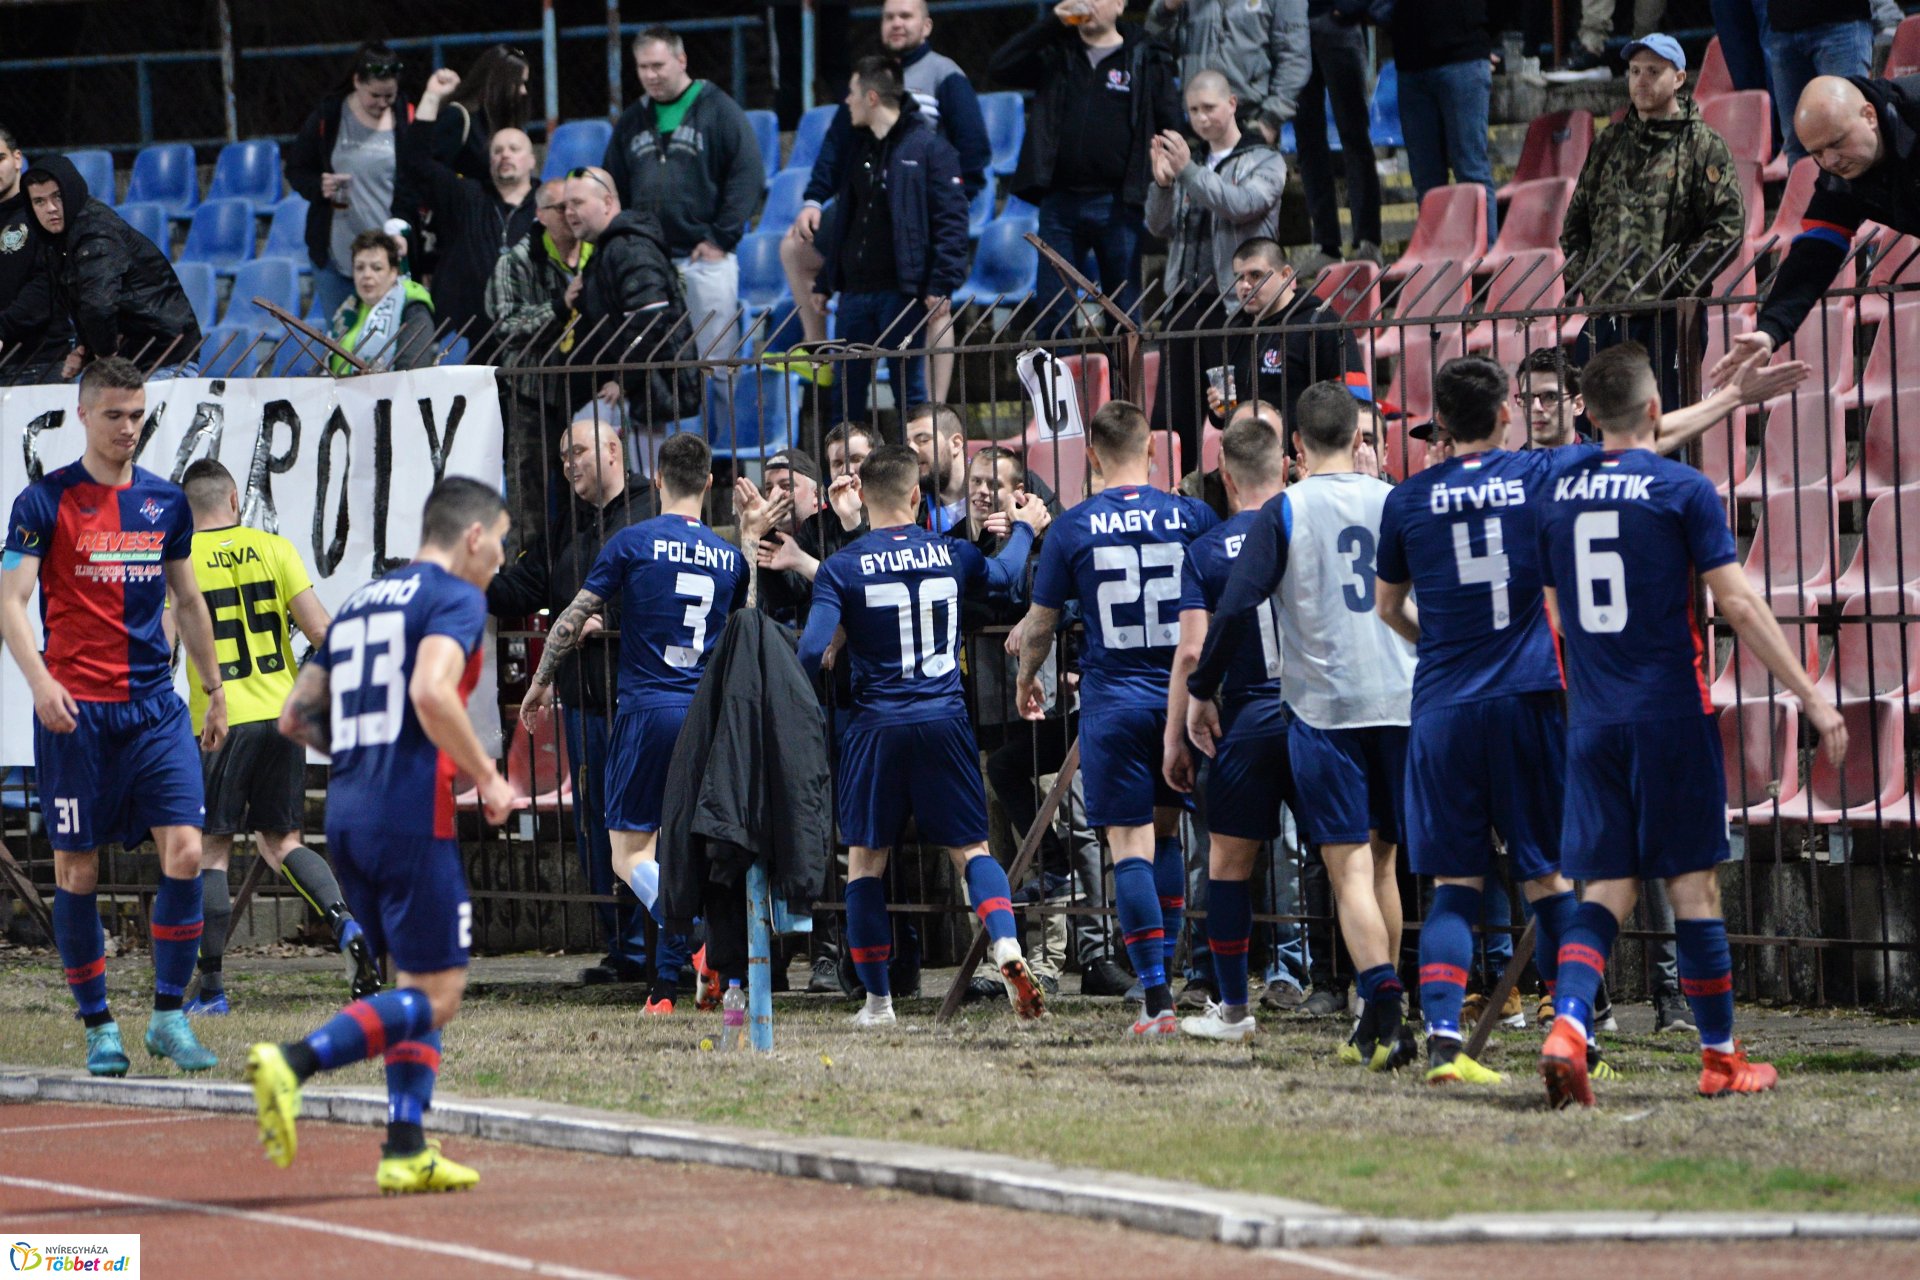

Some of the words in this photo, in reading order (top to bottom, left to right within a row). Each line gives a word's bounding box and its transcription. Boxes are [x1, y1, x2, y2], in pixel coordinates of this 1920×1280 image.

[1090, 508, 1157, 535] NAGY
[1164, 507, 1188, 530] J.
[1430, 477, 1526, 515] ÖTVÖS
[1554, 469, 1655, 502] KÁRTIK
[206, 546, 261, 569] JOVA
[653, 539, 735, 572] POLÉNYI
[860, 541, 953, 576] GYURJÁN
[1092, 541, 1186, 650] 22
[1337, 525, 1377, 613] 3
[1451, 516, 1511, 631] 4
[1573, 510, 1629, 633] 6
[201, 579, 286, 682] 55
[663, 571, 715, 668] 3
[864, 576, 959, 679] 70
[329, 610, 406, 753] 23
[54, 797, 80, 834] 31
